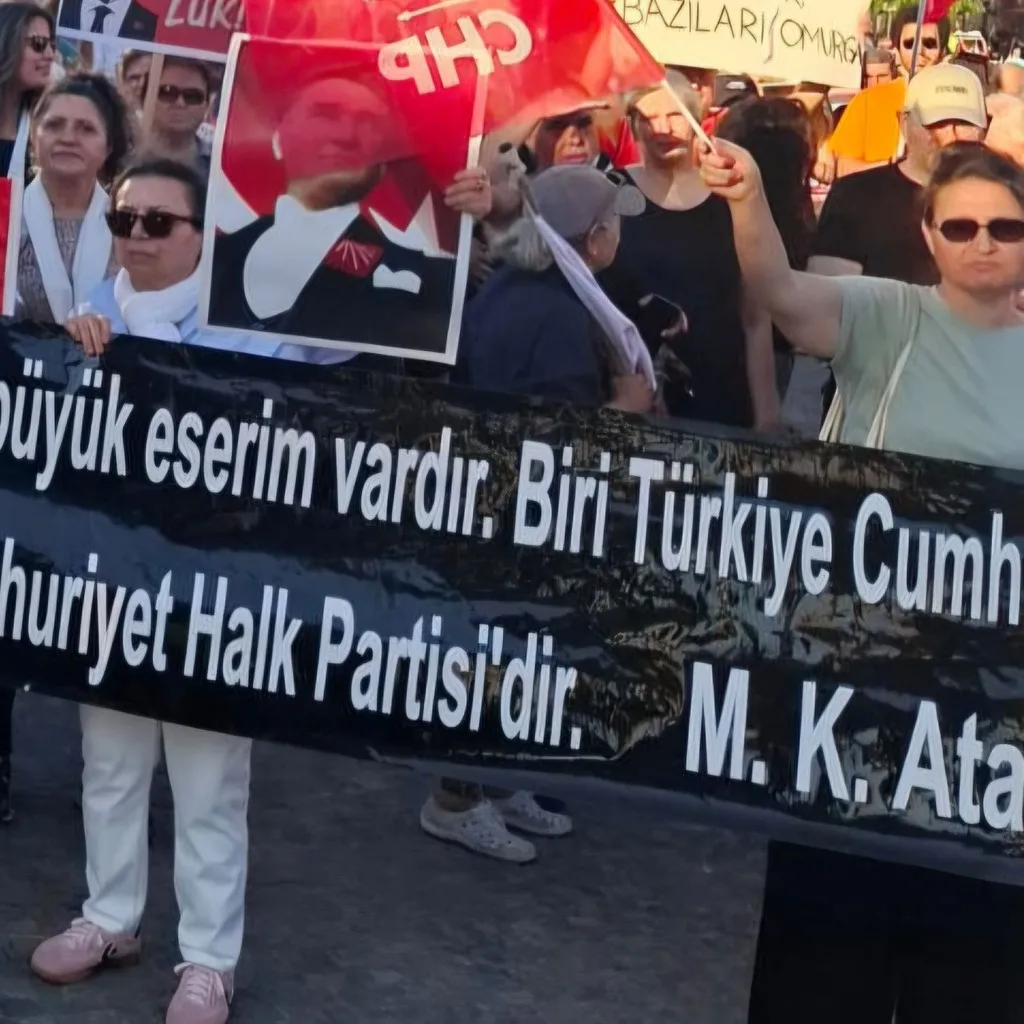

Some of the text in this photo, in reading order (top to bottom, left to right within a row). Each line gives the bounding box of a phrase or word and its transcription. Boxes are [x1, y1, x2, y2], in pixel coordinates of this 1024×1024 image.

[145, 398, 316, 508] eserim
[335, 426, 494, 539] vardır.
[513, 440, 611, 557] Biri
[628, 457, 833, 617] Türkiye
[853, 492, 1022, 625] Cumh
[184, 572, 303, 696] Halk
[313, 596, 582, 750] Partisi'dir.
[685, 661, 1024, 831] M. K. Ata
